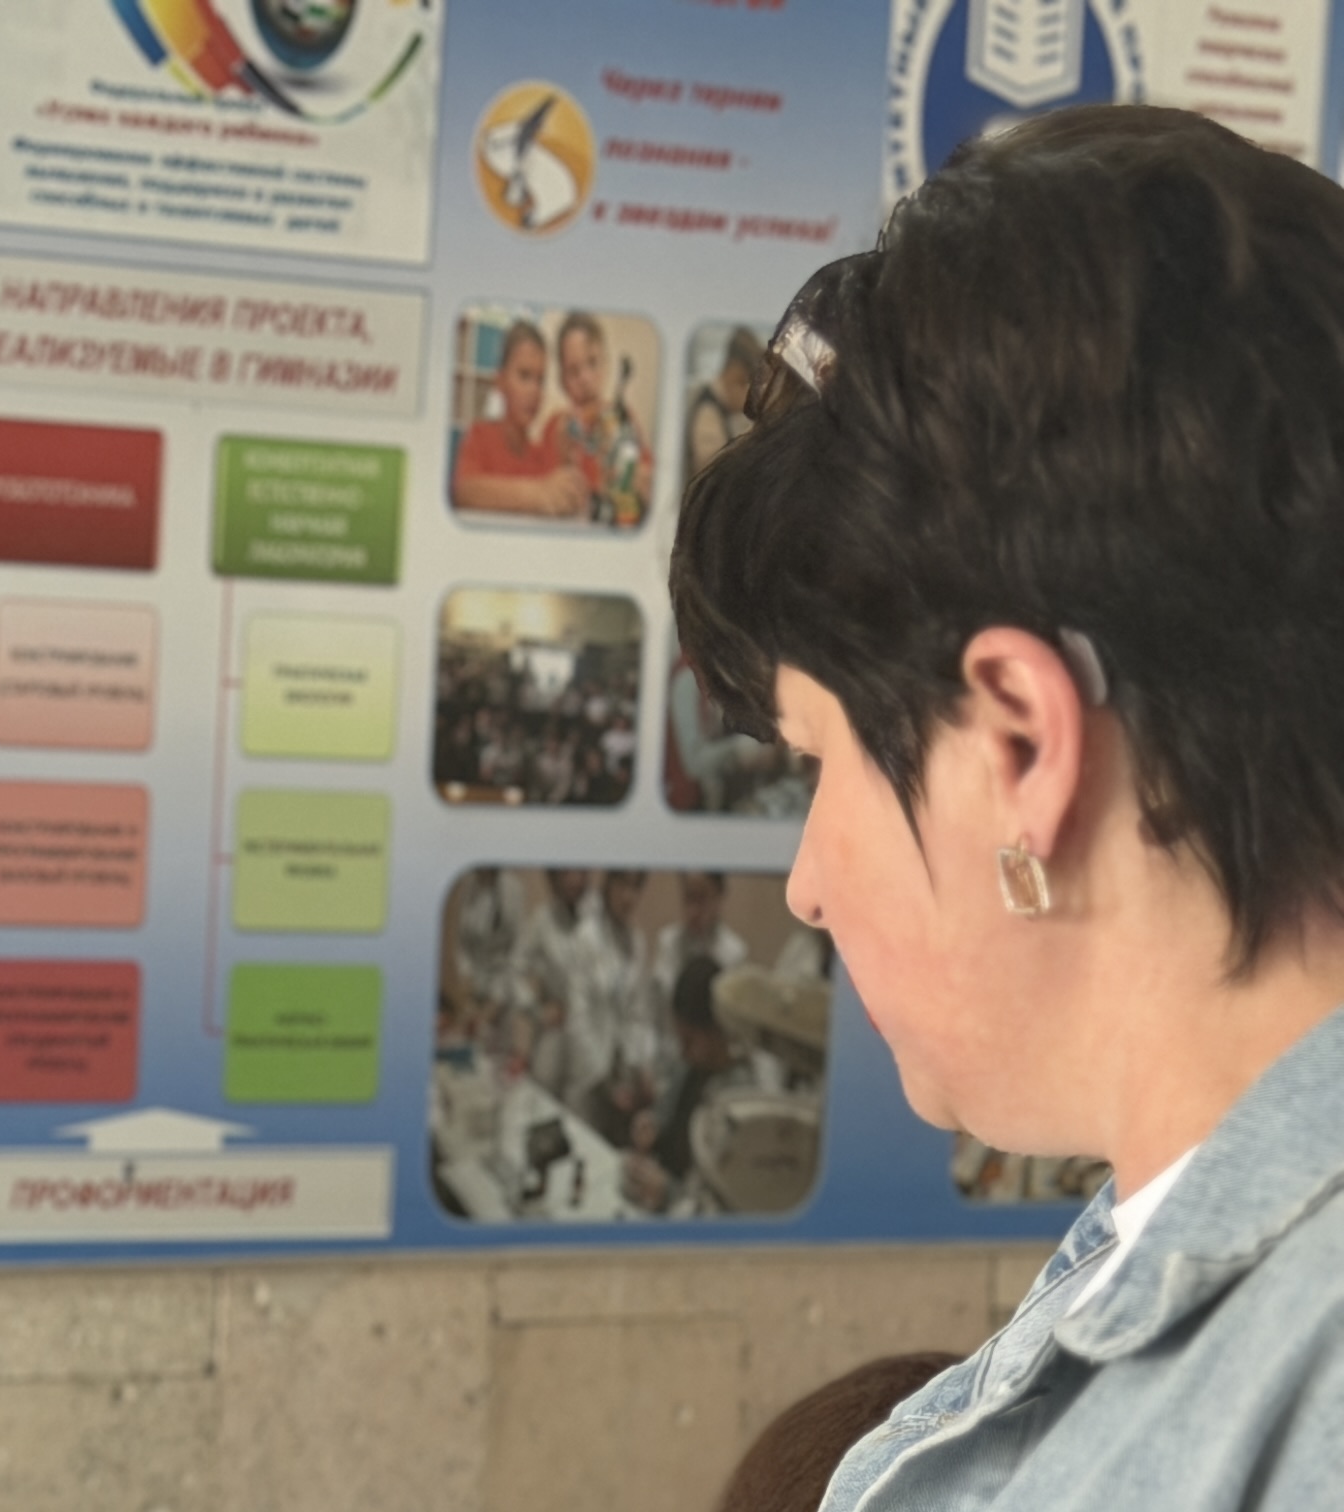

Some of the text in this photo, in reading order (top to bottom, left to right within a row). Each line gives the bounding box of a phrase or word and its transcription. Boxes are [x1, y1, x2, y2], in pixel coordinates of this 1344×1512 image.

[231, 299, 373, 346] ПРОЕКТА,
[209, 348, 233, 383] В
[238, 351, 400, 394] ГИМНАЗИИ
[9, 1174, 296, 1214] ПРОФОРИЕНТАЦИЯ
